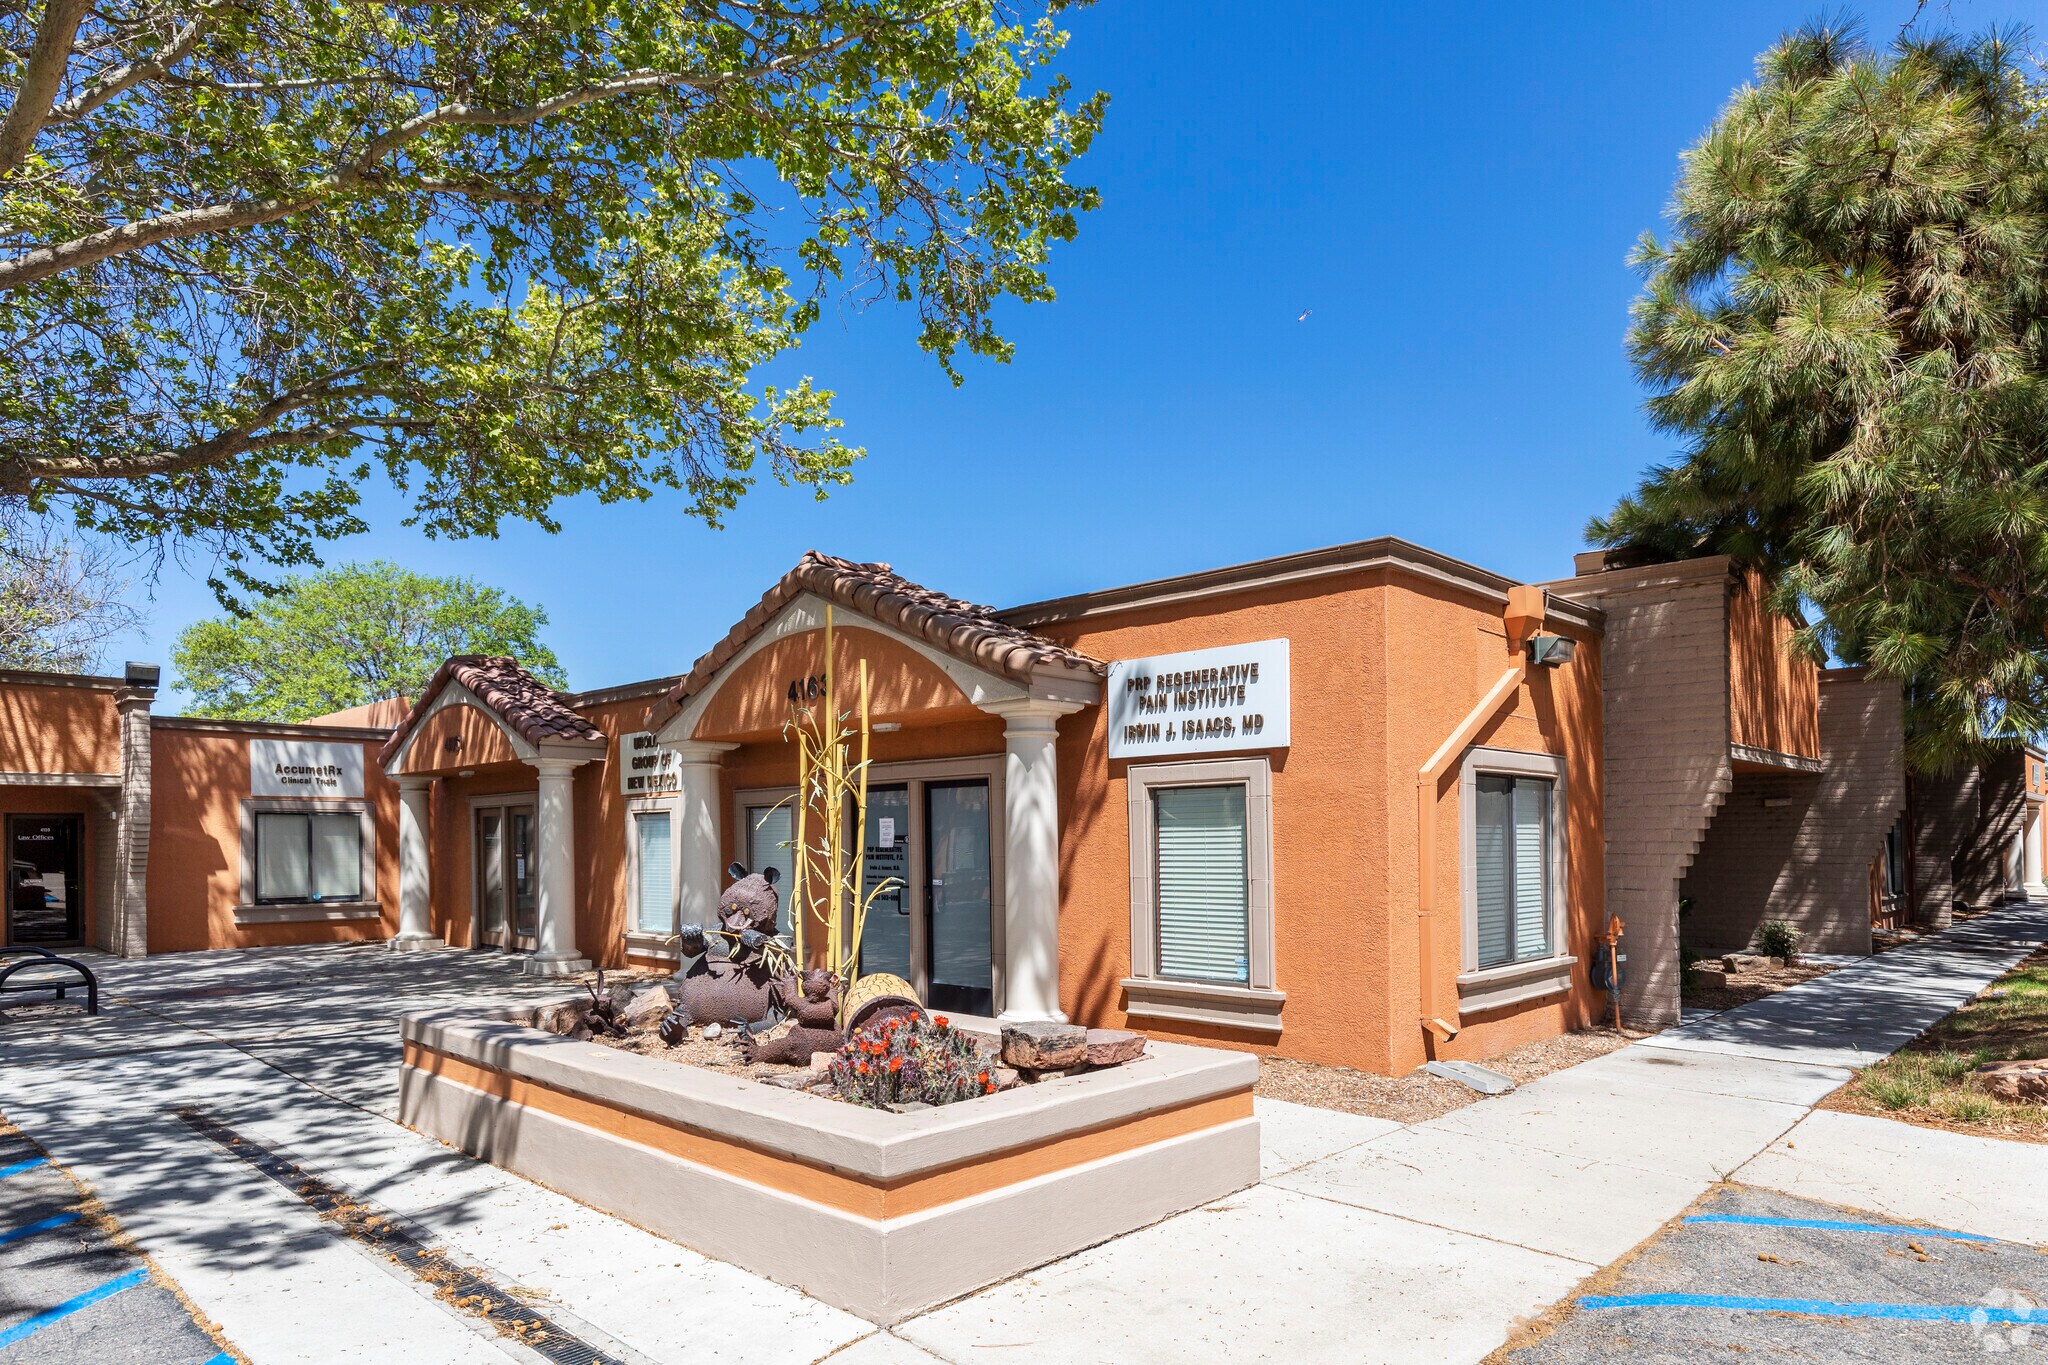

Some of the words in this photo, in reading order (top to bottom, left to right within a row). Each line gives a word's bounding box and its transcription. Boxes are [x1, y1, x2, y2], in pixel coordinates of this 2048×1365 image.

[1127, 676, 1151, 692] PRP
[1157, 662, 1259, 689] REGENERATIVE
[1139, 693, 1168, 710] PAIN
[1174, 685, 1246, 706] INSTITUTE
[1124, 722, 1160, 740] IRWIN
[1182, 716, 1236, 735] ISAACS,
[1242, 714, 1265, 730] MD
[275, 763, 342, 775] AccumetRx
[632, 755, 658, 769] GROUP
[281, 777, 312, 785] Clinical
[316, 777, 337, 787] Trials
[628, 776, 645, 789] NEW
